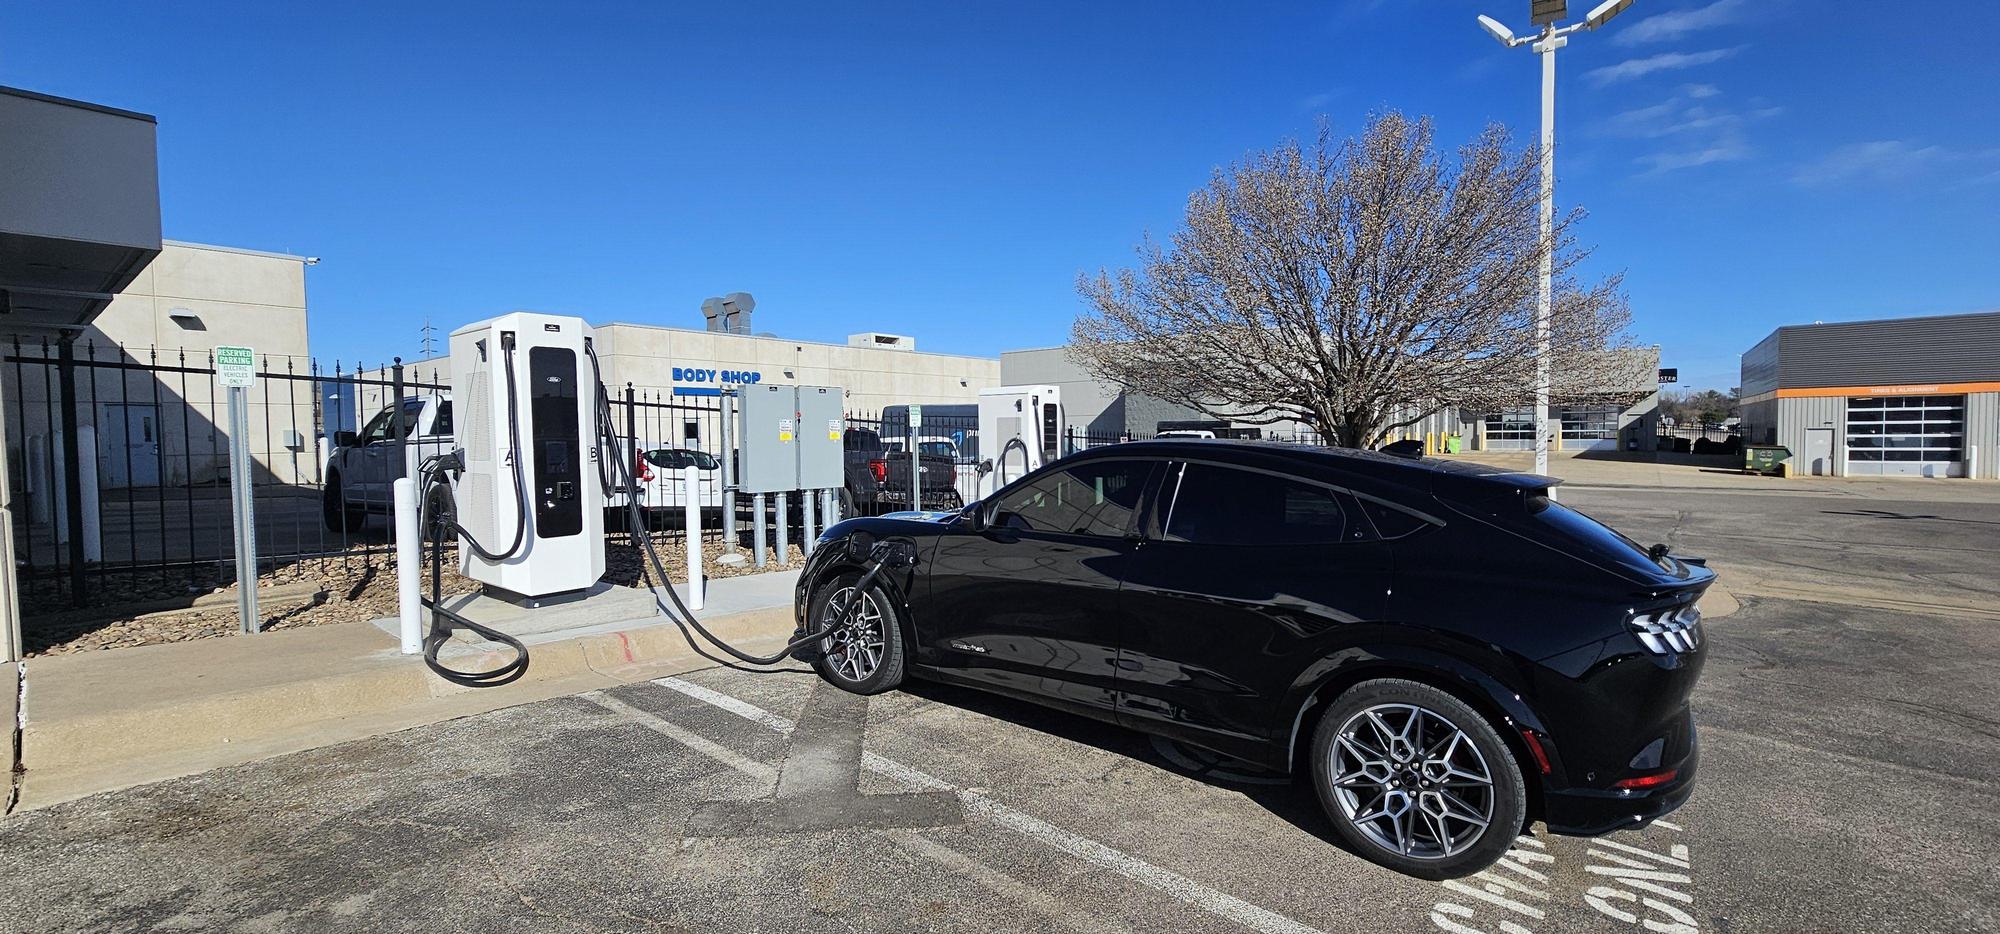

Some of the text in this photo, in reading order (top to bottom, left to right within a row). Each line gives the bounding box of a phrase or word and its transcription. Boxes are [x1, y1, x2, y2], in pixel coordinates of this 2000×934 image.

[218, 349, 251, 357] RESERVED
[220, 356, 250, 365] PARKING
[672, 367, 760, 384] BODY SHOP
[591, 447, 598, 458] B
